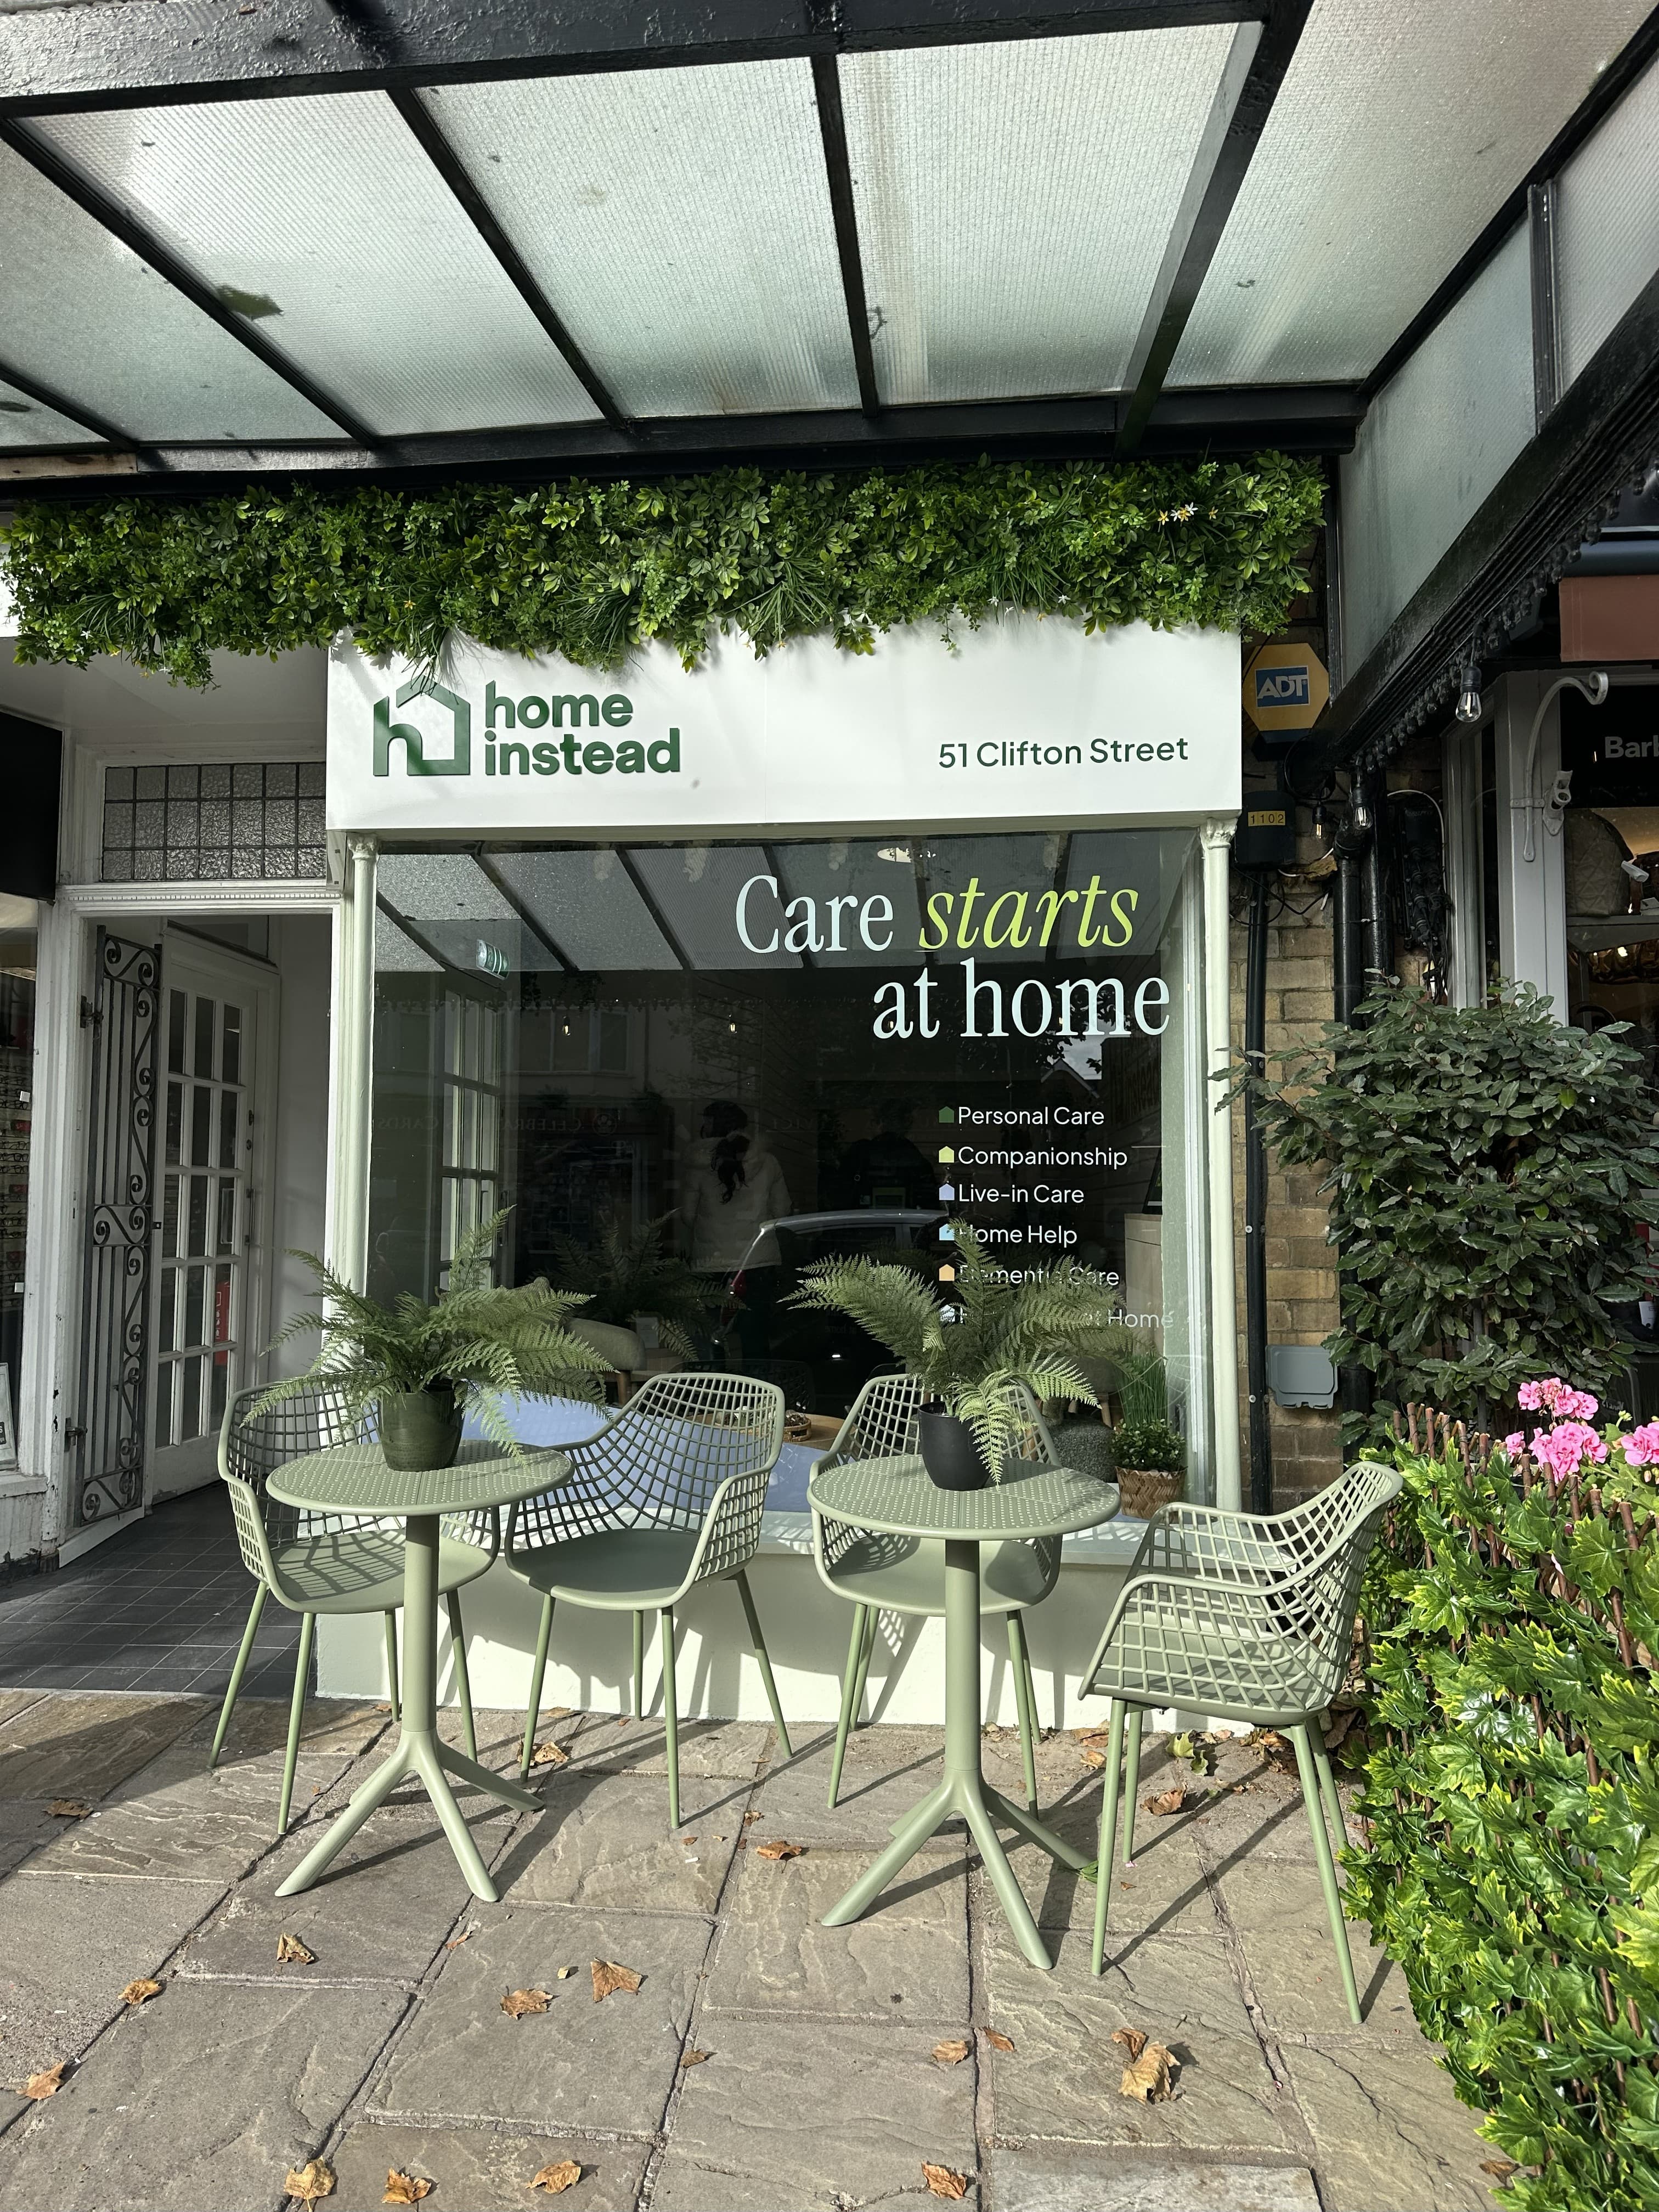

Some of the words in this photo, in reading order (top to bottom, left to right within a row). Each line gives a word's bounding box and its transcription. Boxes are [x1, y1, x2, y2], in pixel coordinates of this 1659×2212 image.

[1257, 675, 1308, 699] ADT
[485, 680, 633, 728] home
[484, 727, 680, 775] instead
[939, 743, 967, 768] 51
[977, 741, 1081, 767] Clifton
[1090, 738, 1188, 763] Street
[1250, 814, 1284, 825] 1102
[736, 874, 894, 954] Care
[919, 874, 1139, 950] starts
[873, 967, 940, 1039] at
[960, 957, 1170, 1037] home
[958, 1106, 1048, 1125] Personal
[1054, 1107, 1105, 1125] Care
[958, 1146, 1128, 1170] Companionship
[958, 1184, 1028, 1203] Live-in
[1034, 1184, 1084, 1203] Care
[959, 1224, 1023, 1243] Home
[1028, 1225, 1077, 1248] Help
[1108, 1309, 1174, 1328] Home
